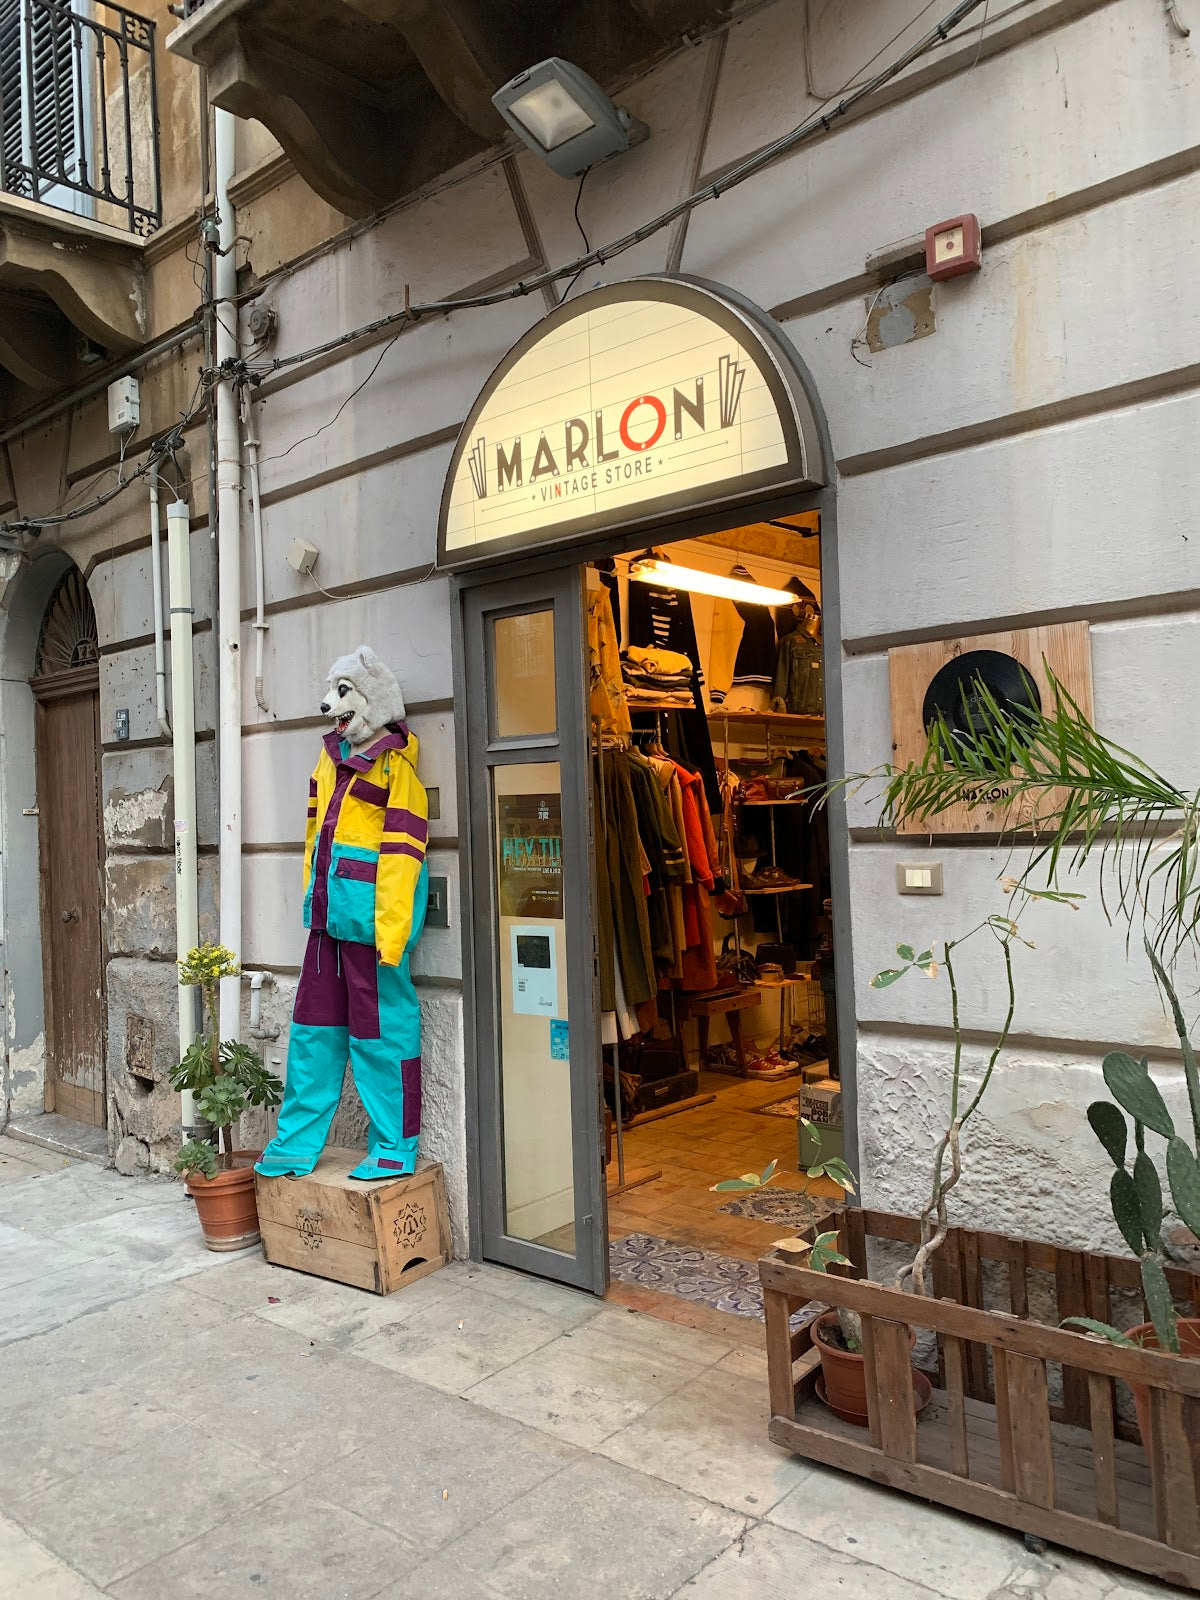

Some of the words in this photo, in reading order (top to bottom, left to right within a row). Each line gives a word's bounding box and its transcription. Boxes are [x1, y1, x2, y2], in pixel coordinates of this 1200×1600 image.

[496, 376, 706, 493] MARLON
[540, 472, 598, 503] VINTAGE
[605, 456, 653, 485] STORE
